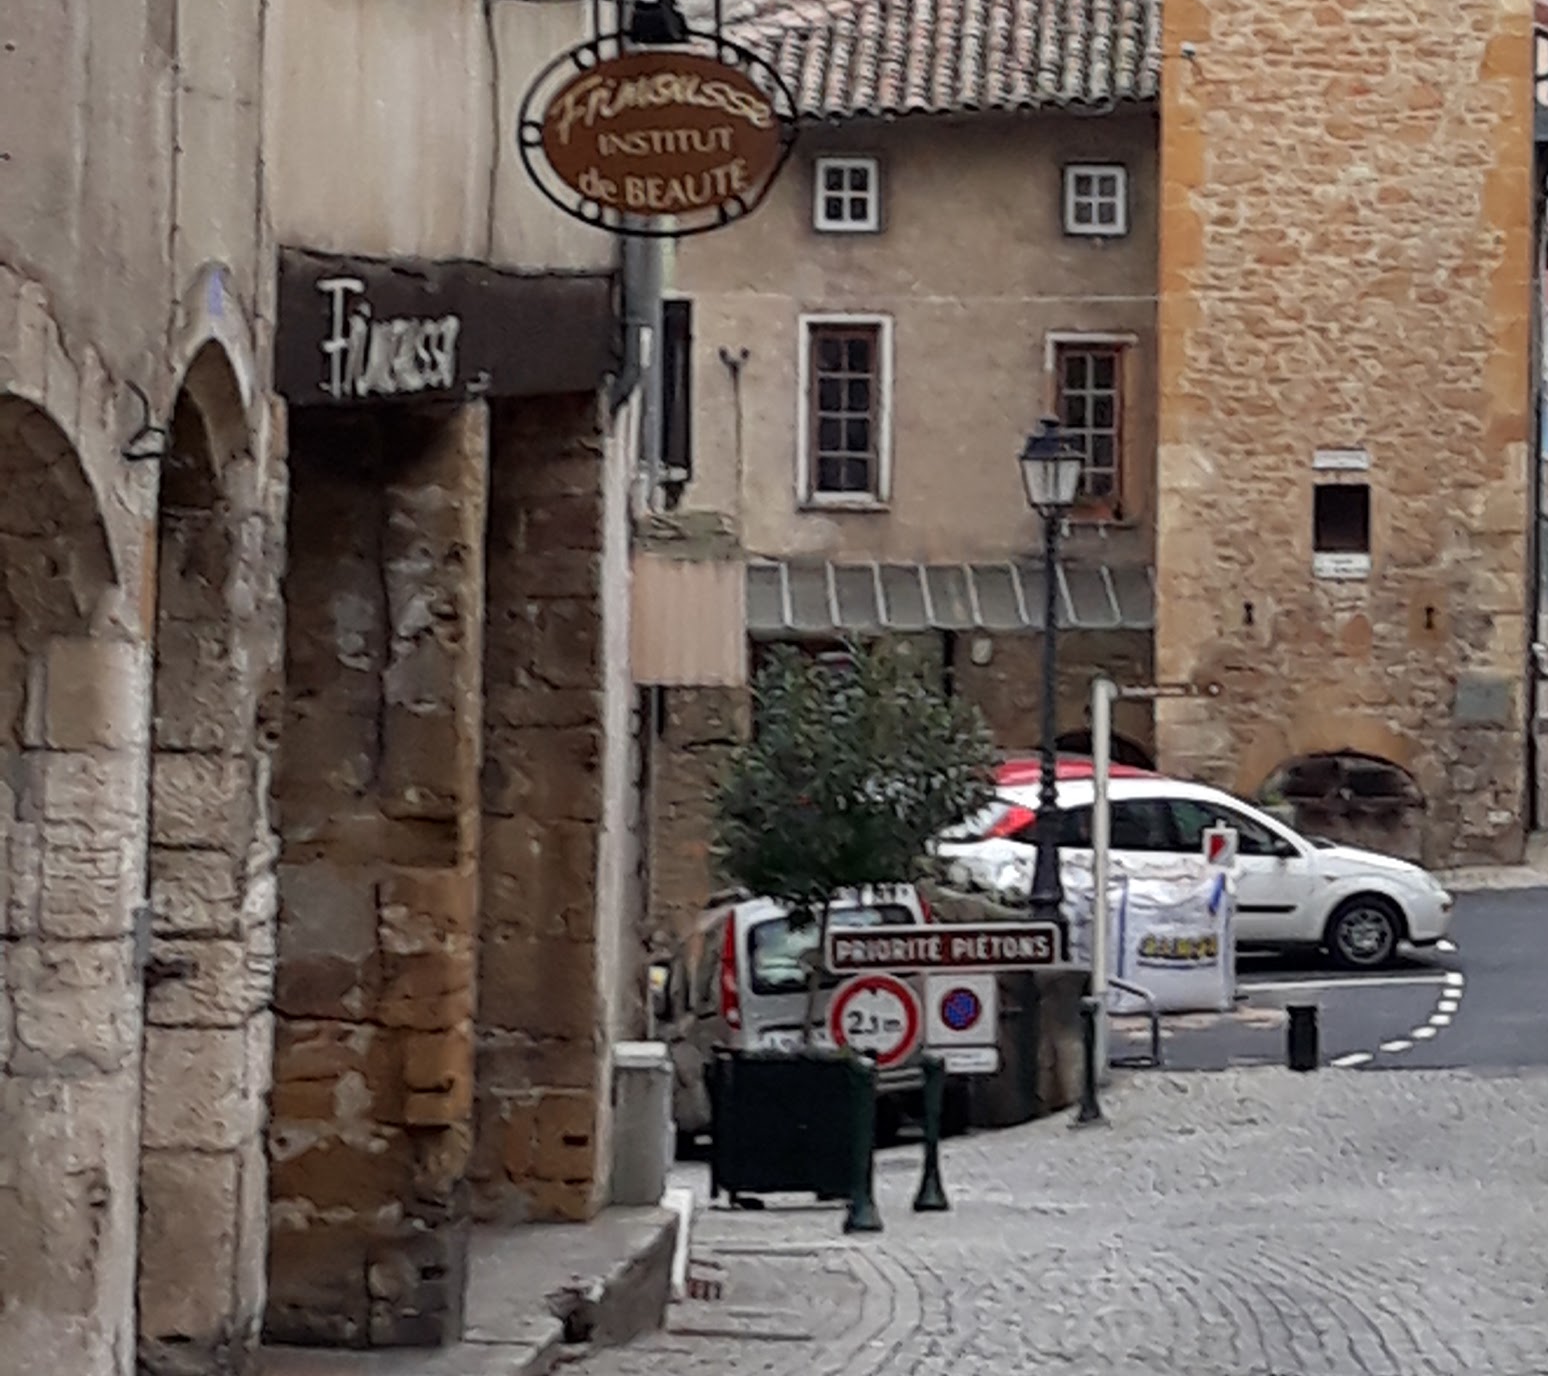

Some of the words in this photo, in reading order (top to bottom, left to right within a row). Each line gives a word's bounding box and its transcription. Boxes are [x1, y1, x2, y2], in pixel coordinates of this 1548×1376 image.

[597, 126, 735, 156] INSTITUT
[577, 167, 618, 203] de
[951, 931, 1051, 960] PIÉTONS
